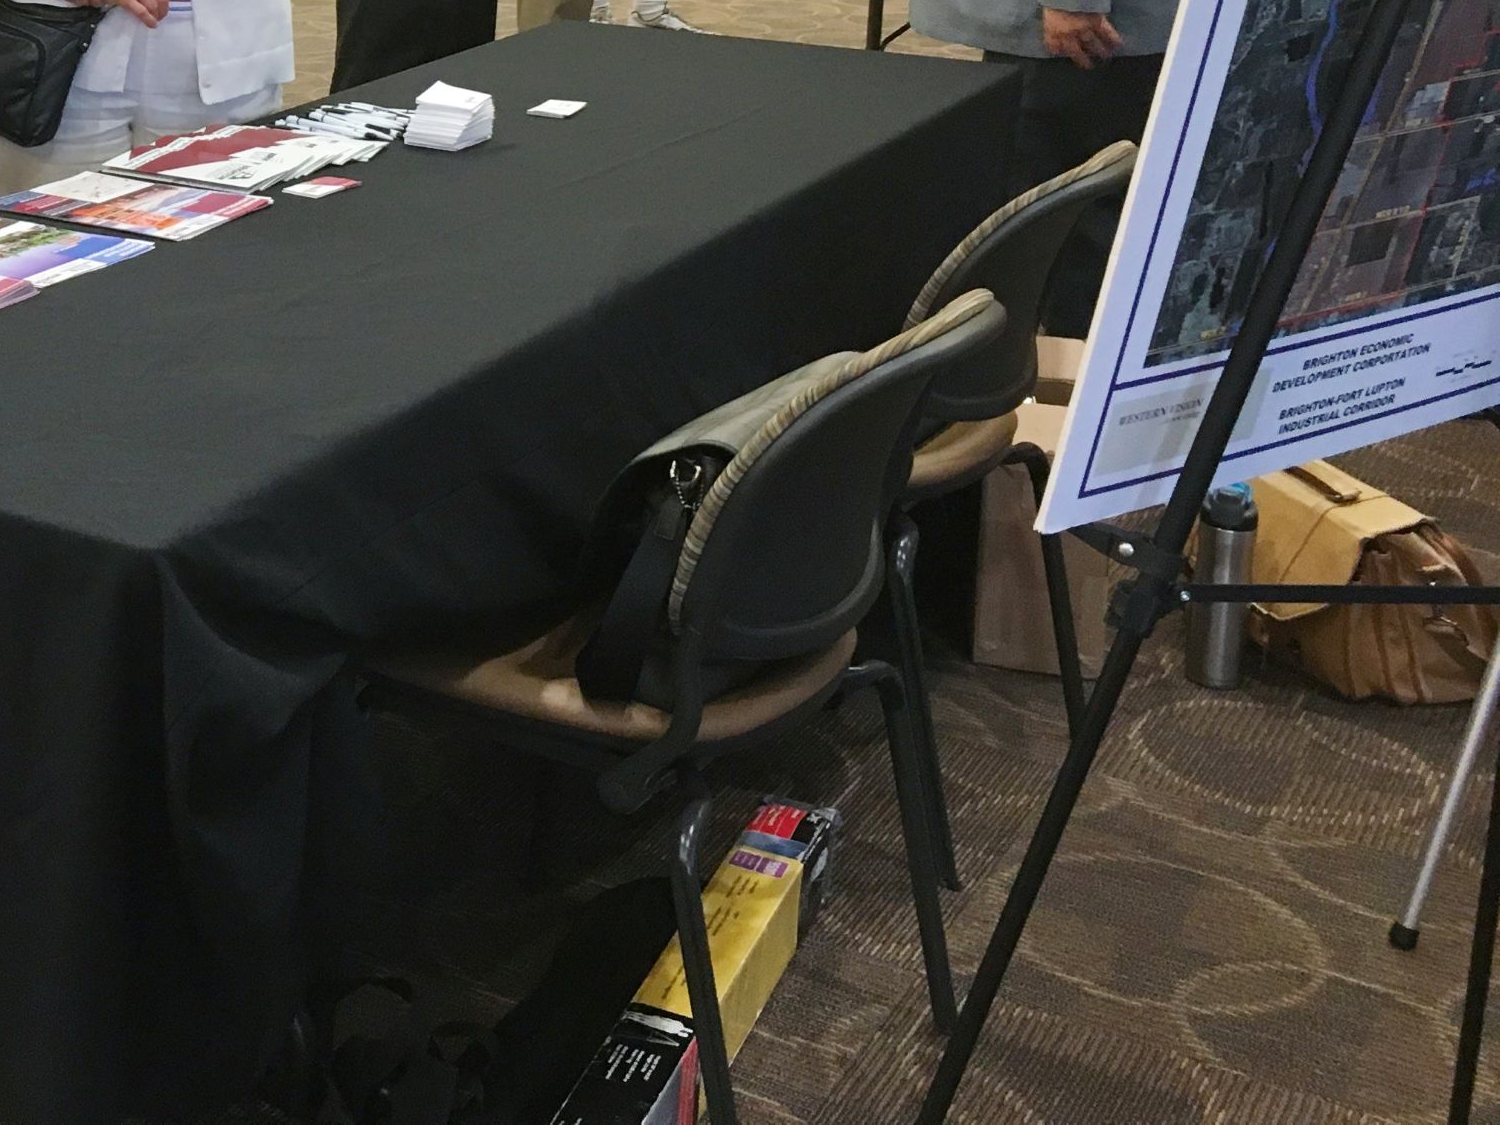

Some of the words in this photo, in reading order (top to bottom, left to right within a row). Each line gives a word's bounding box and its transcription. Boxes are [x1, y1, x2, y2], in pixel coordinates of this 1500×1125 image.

[1302, 348, 1357, 371] BRIGHTON
[1360, 333, 1415, 356] ECONOMIC
[1272, 363, 1351, 393] DEVELOPMENT
[1278, 388, 1364, 421] BRIGHTON-FORT
[1365, 377, 1406, 397] LUPTON
[1278, 410, 1341, 435] INDUSTRIAL
[1342, 394, 1396, 417] CORRIDOR
